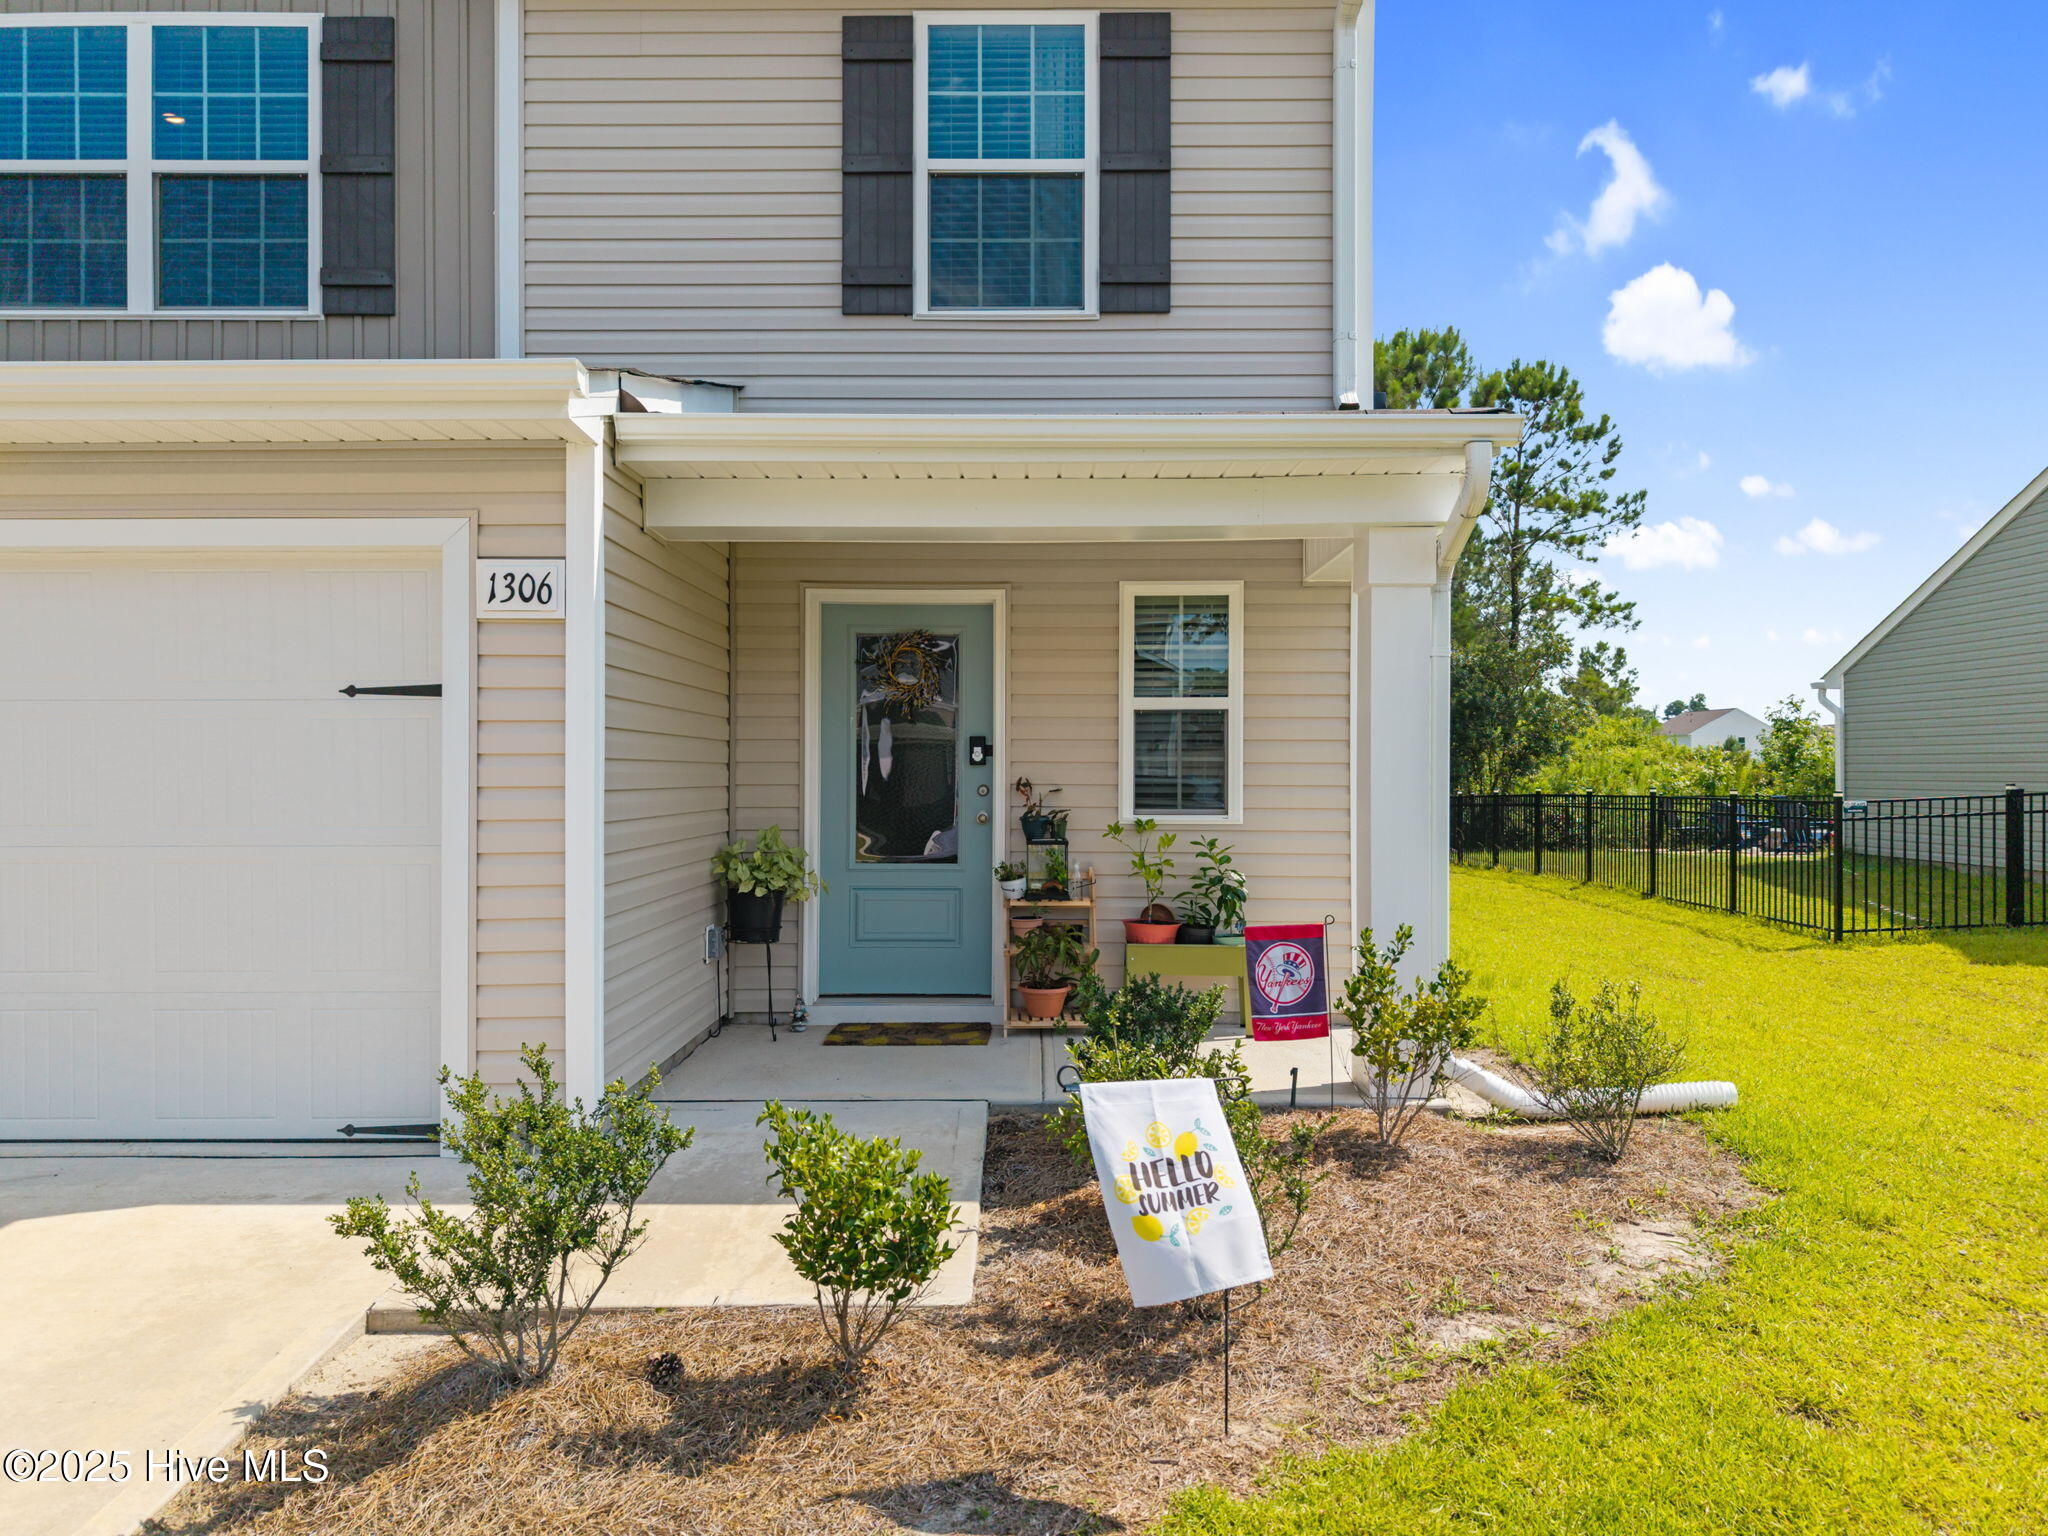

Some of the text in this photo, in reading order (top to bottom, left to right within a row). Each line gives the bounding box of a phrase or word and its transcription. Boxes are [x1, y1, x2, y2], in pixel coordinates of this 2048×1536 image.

[487, 571, 553, 605] 1306
[1257, 964, 1311, 990] Yankees
[1274, 1021, 1291, 1034] York
[1291, 1020, 1323, 1034] Yankees
[1129, 1151, 1214, 1191] HELLO
[1138, 1181, 1221, 1216] SUMMER
